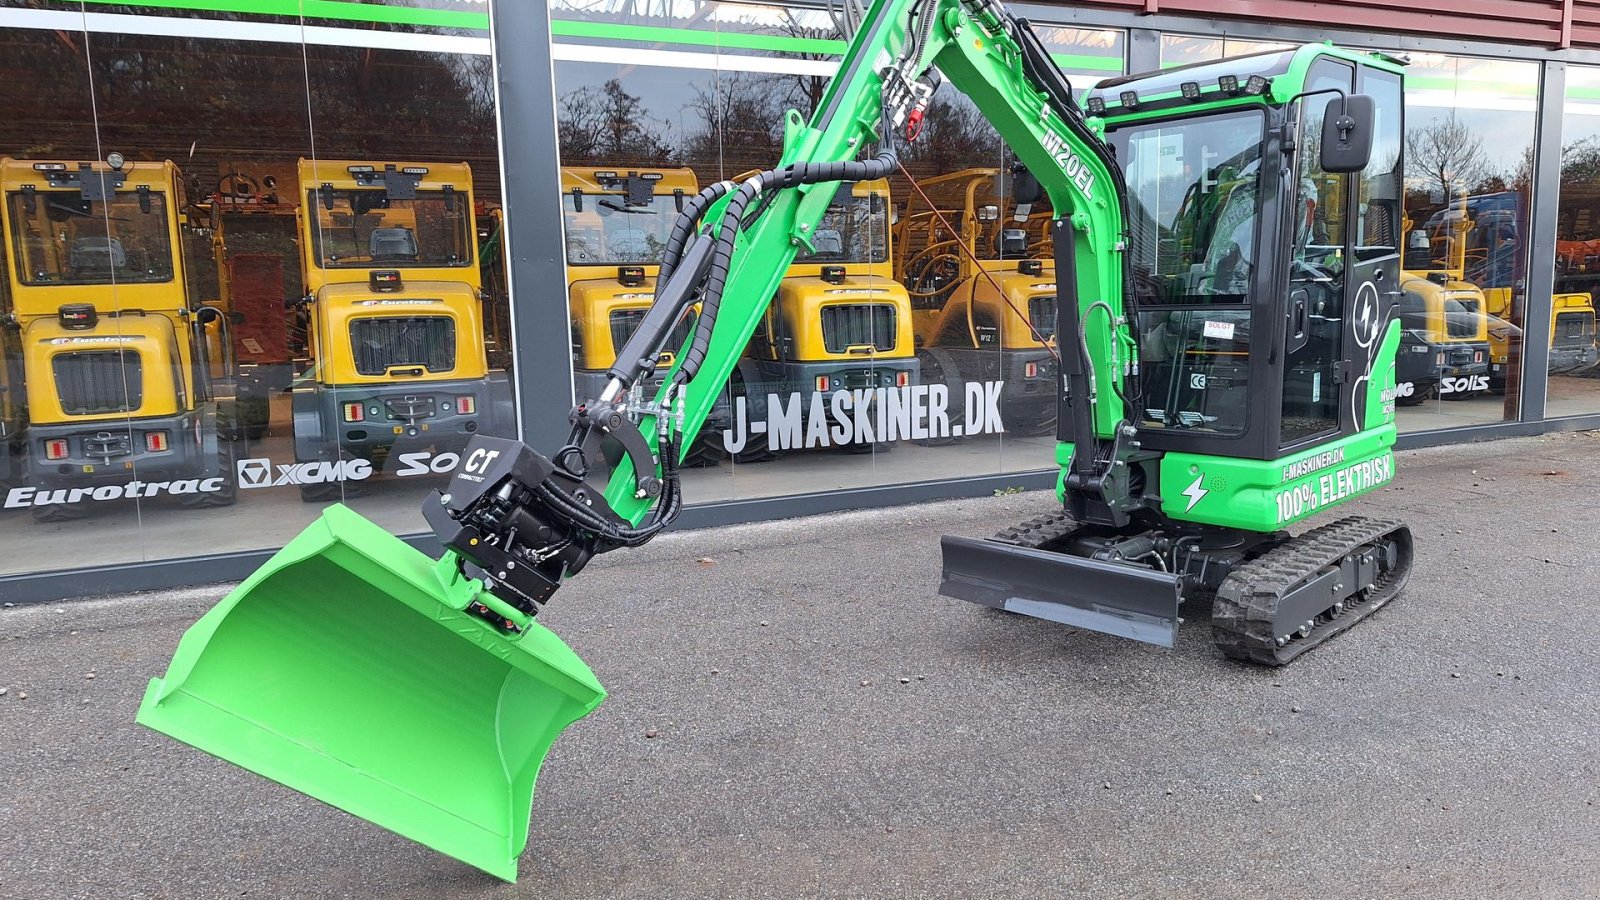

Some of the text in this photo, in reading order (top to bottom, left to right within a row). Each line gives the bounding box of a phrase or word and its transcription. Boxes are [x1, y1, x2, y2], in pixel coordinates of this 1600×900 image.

[1041, 128, 1097, 201] M20EL
[1208, 322, 1231, 330] SOLGT
[722, 380, 1004, 454] J-MASKINER.DK
[270, 458, 373, 487] XCMG
[465, 447, 500, 475] CT
[1281, 446, 1345, 484] J-MASKINER.DK
[3, 477, 225, 509] Eurotrac
[1276, 453, 1391, 525] 100% ELEKTRISK
